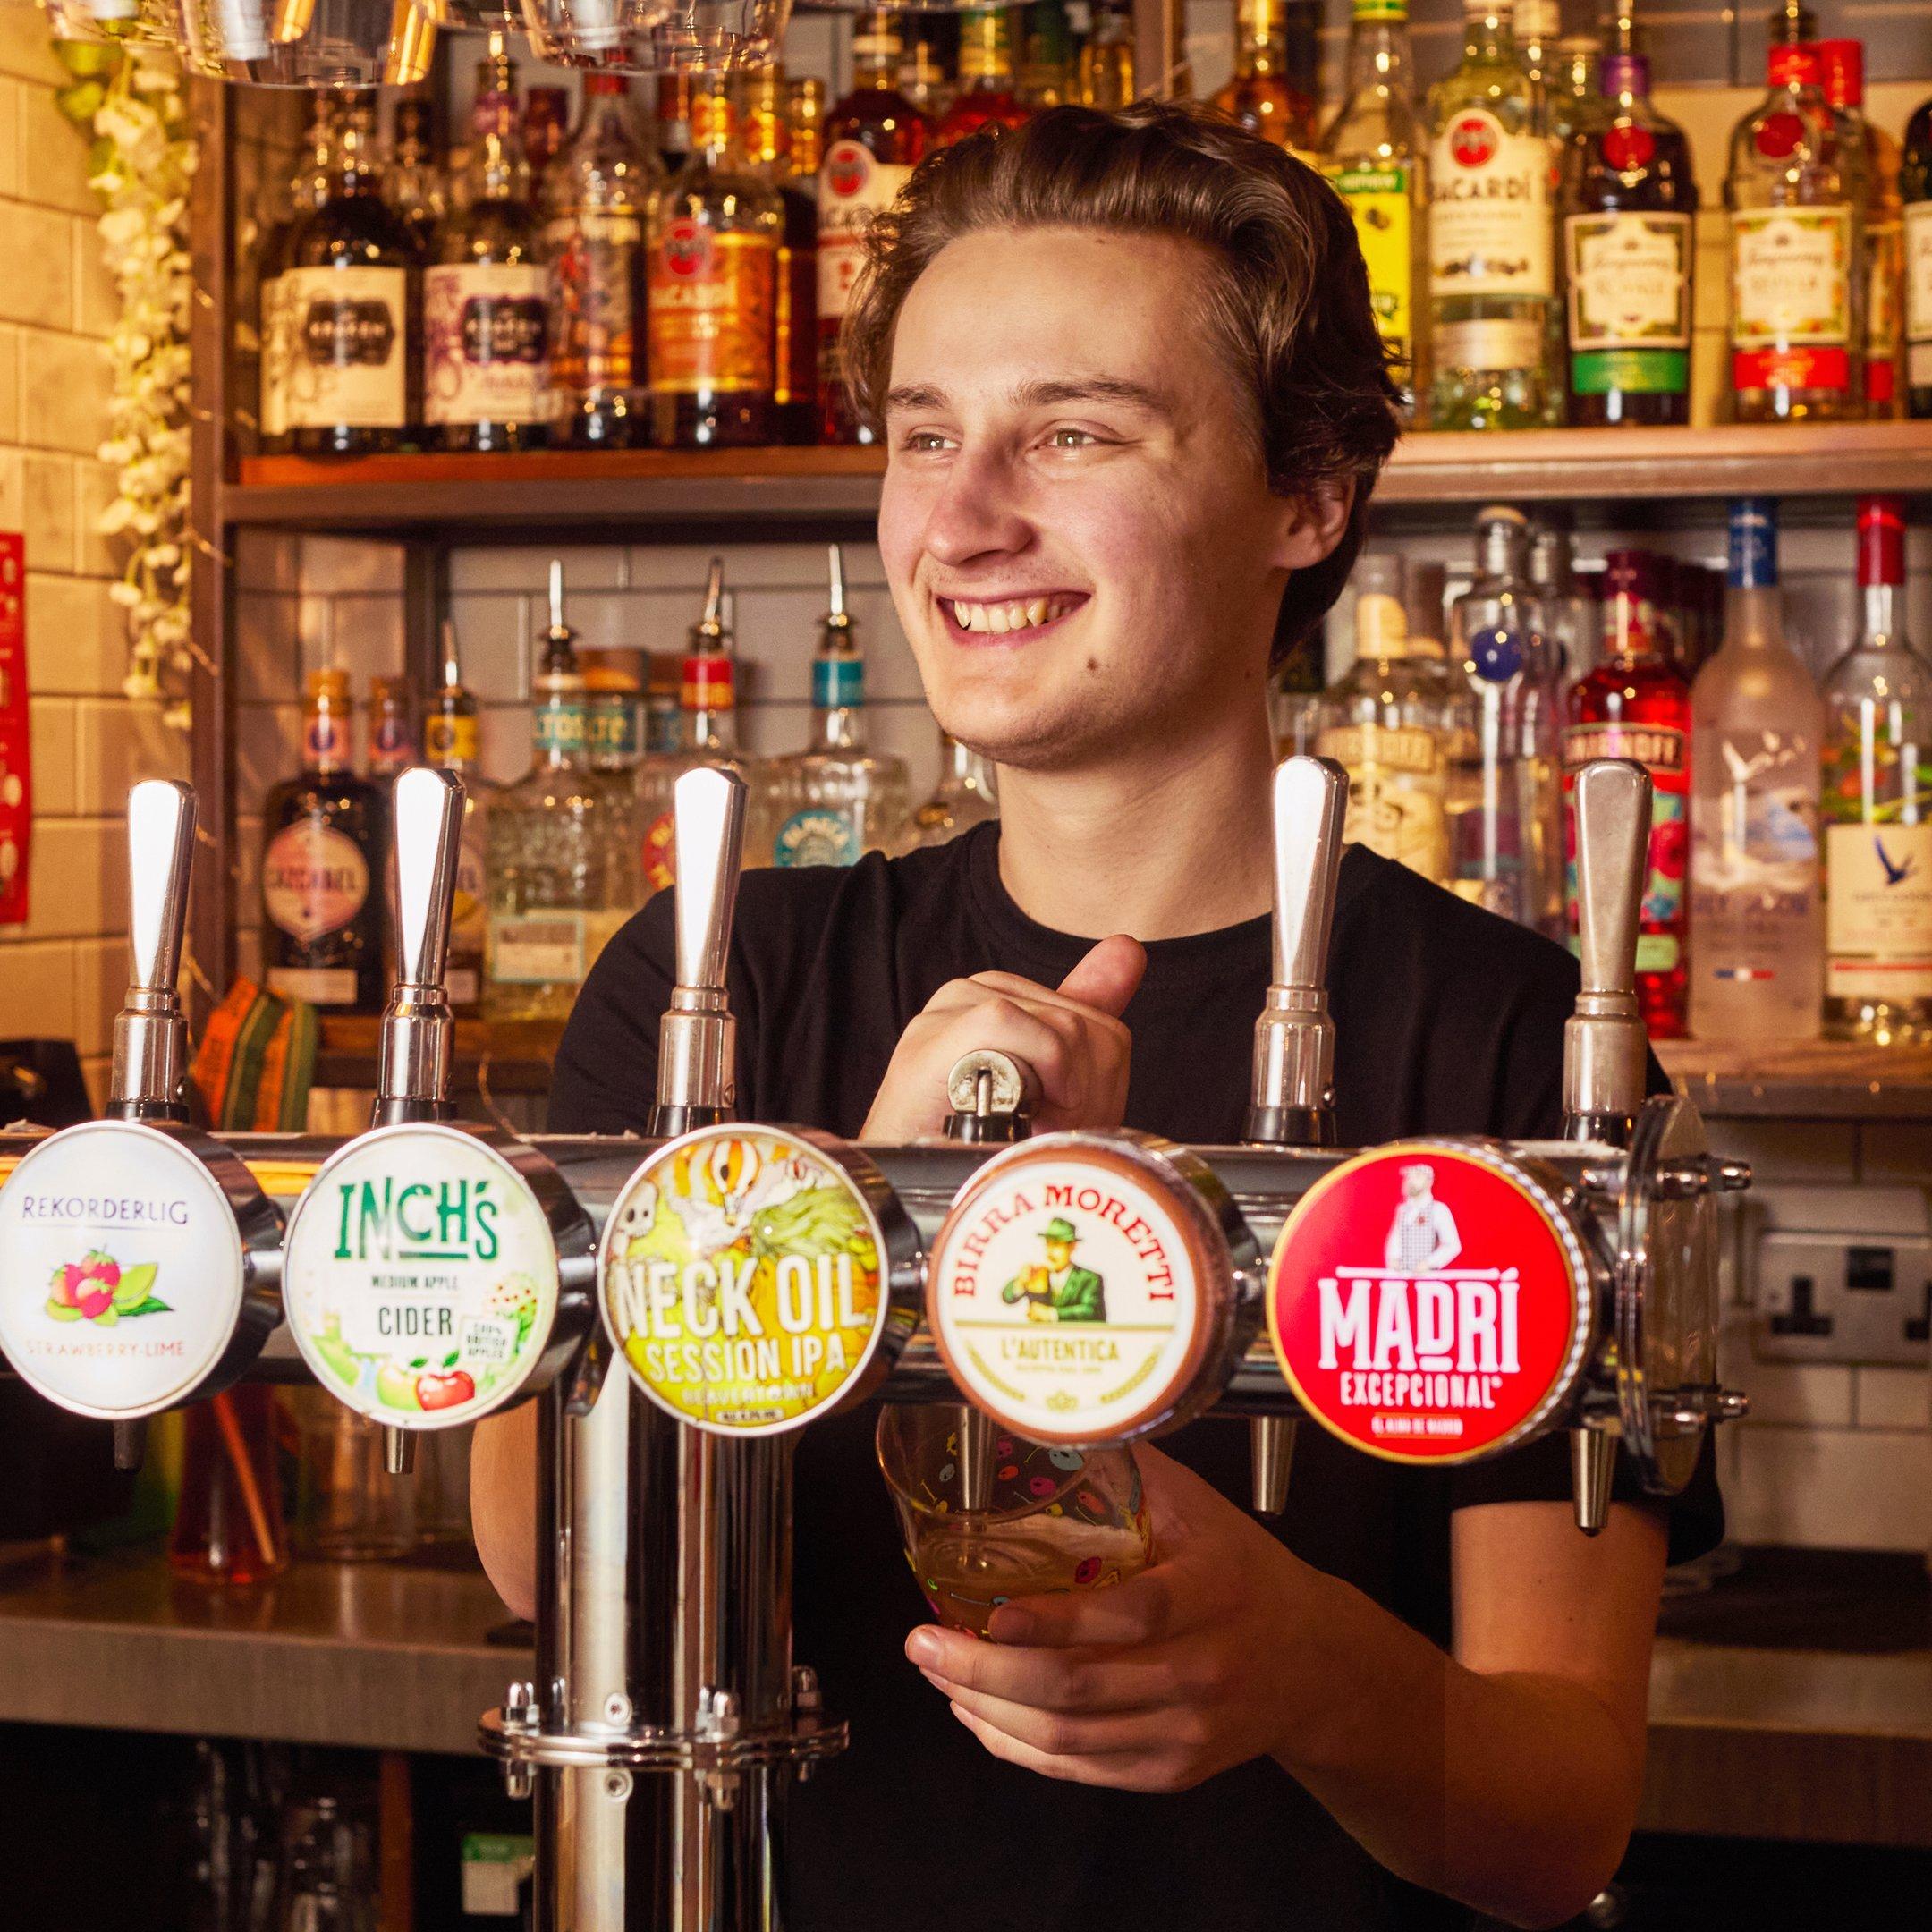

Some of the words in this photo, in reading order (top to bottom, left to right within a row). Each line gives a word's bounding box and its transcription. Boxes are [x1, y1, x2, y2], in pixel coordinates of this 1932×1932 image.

[21, 1196, 188, 1225] REKORDERLIG
[335, 1177, 498, 1260] INCH'S
[953, 1192, 1034, 1298] BIRRA
[1045, 1185, 1174, 1301] MORETTI
[378, 1306, 453, 1336] CIDER
[614, 1256, 763, 1340] NECK
[776, 1252, 875, 1334] OIL
[1318, 1267, 1521, 1374] MADRÍ
[645, 1336, 782, 1384] SESSION
[791, 1332, 848, 1378] IPA
[1001, 1336, 1119, 1361] L'AUTENTICA
